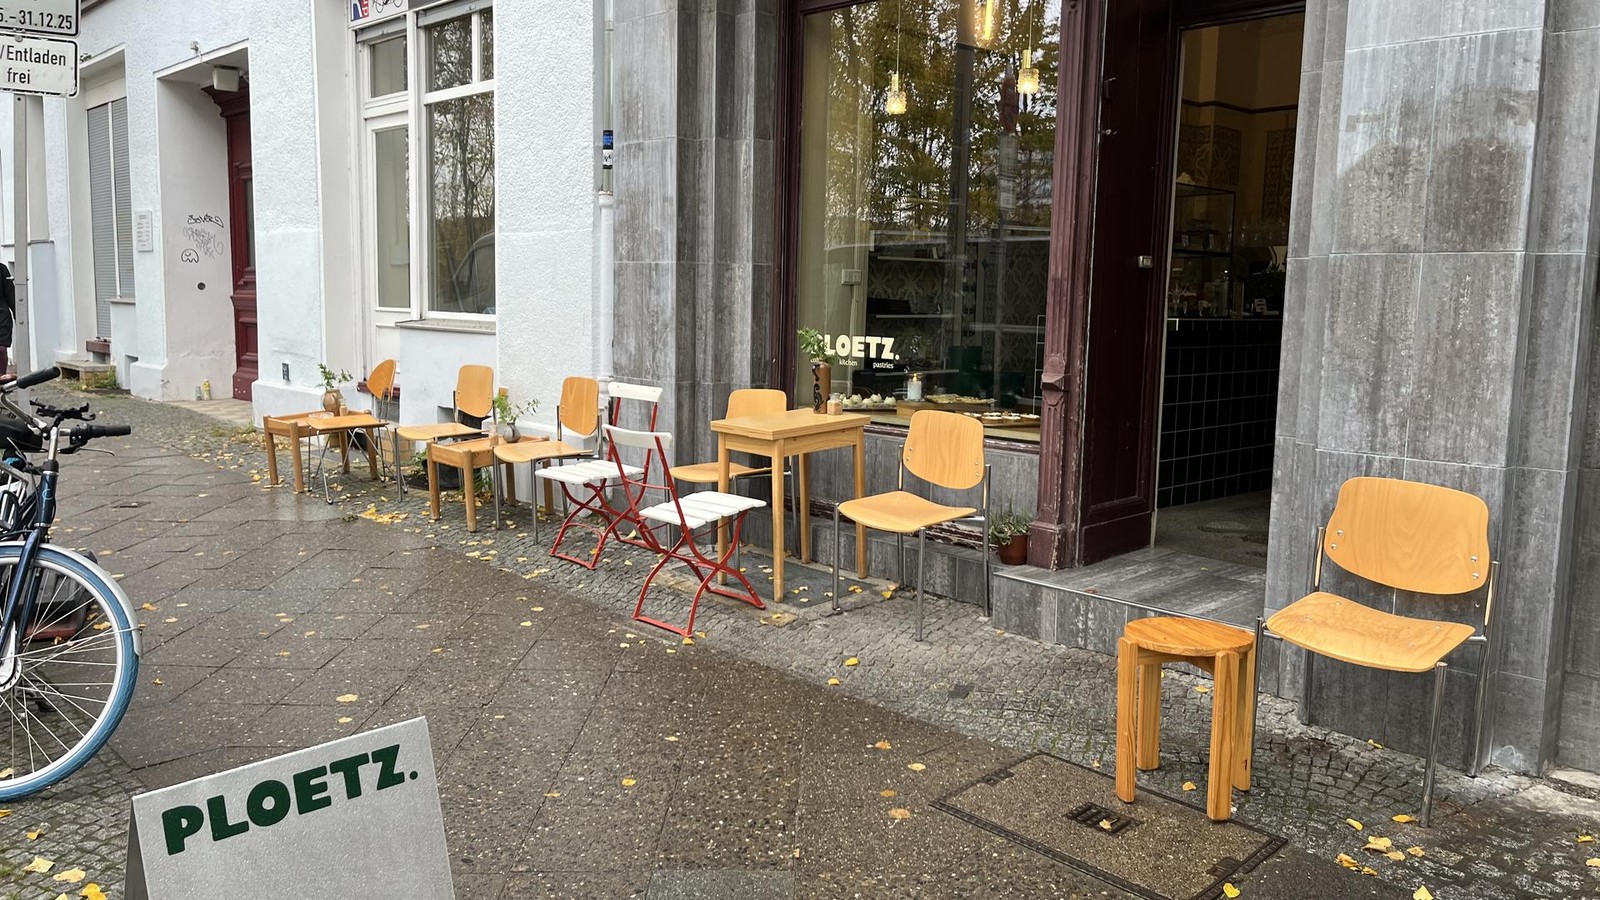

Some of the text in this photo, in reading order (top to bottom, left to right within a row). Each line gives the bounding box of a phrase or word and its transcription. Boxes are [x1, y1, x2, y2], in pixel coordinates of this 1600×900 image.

[7, 67, 31, 84] frei
[811, 334, 900, 360] LOETZ.
[873, 361, 894, 369] pastries
[162, 743, 419, 856] PLOETZ.
